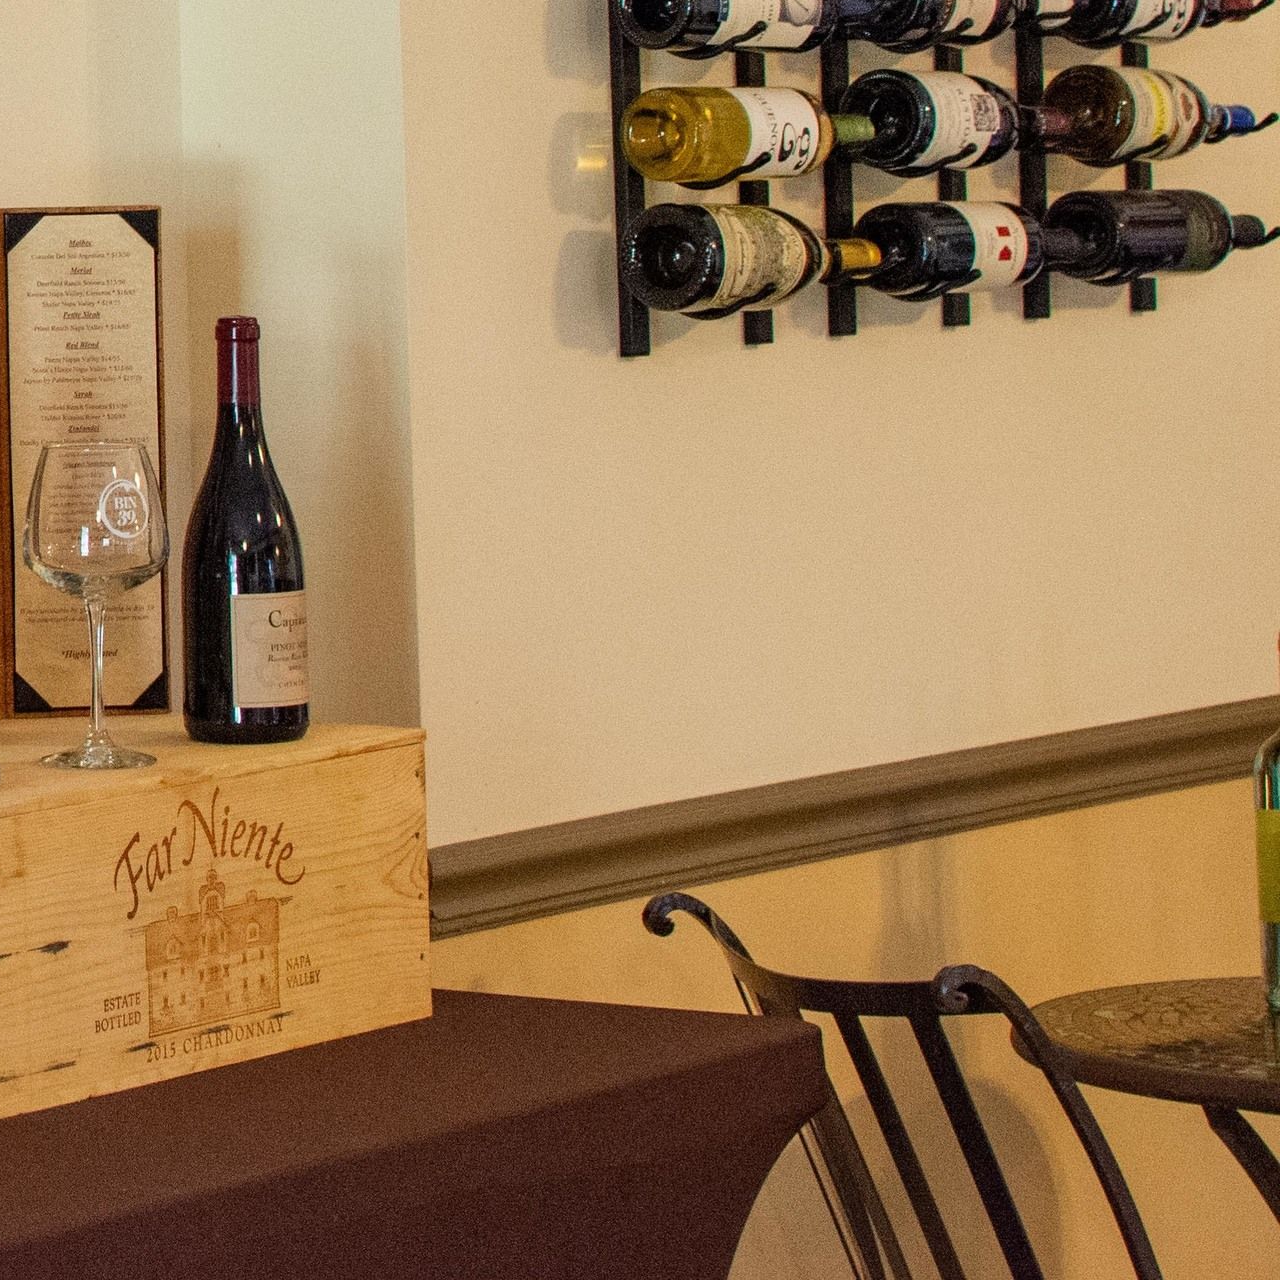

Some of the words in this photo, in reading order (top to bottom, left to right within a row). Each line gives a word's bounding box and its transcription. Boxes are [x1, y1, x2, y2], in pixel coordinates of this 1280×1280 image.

[114, 496, 137, 510] BIN
[117, 509, 137, 527] 39
[112, 825, 178, 921] Far
[176, 786, 307, 886] Niente
[284, 953, 313, 973] NAPA
[285, 969, 322, 990] VALLEY
[102, 991, 142, 1014] ESTATE
[93, 1010, 143, 1035] BOTTLED
[145, 1042, 179, 1064] 2015
[182, 1016, 285, 1055] CHARDONNAY
